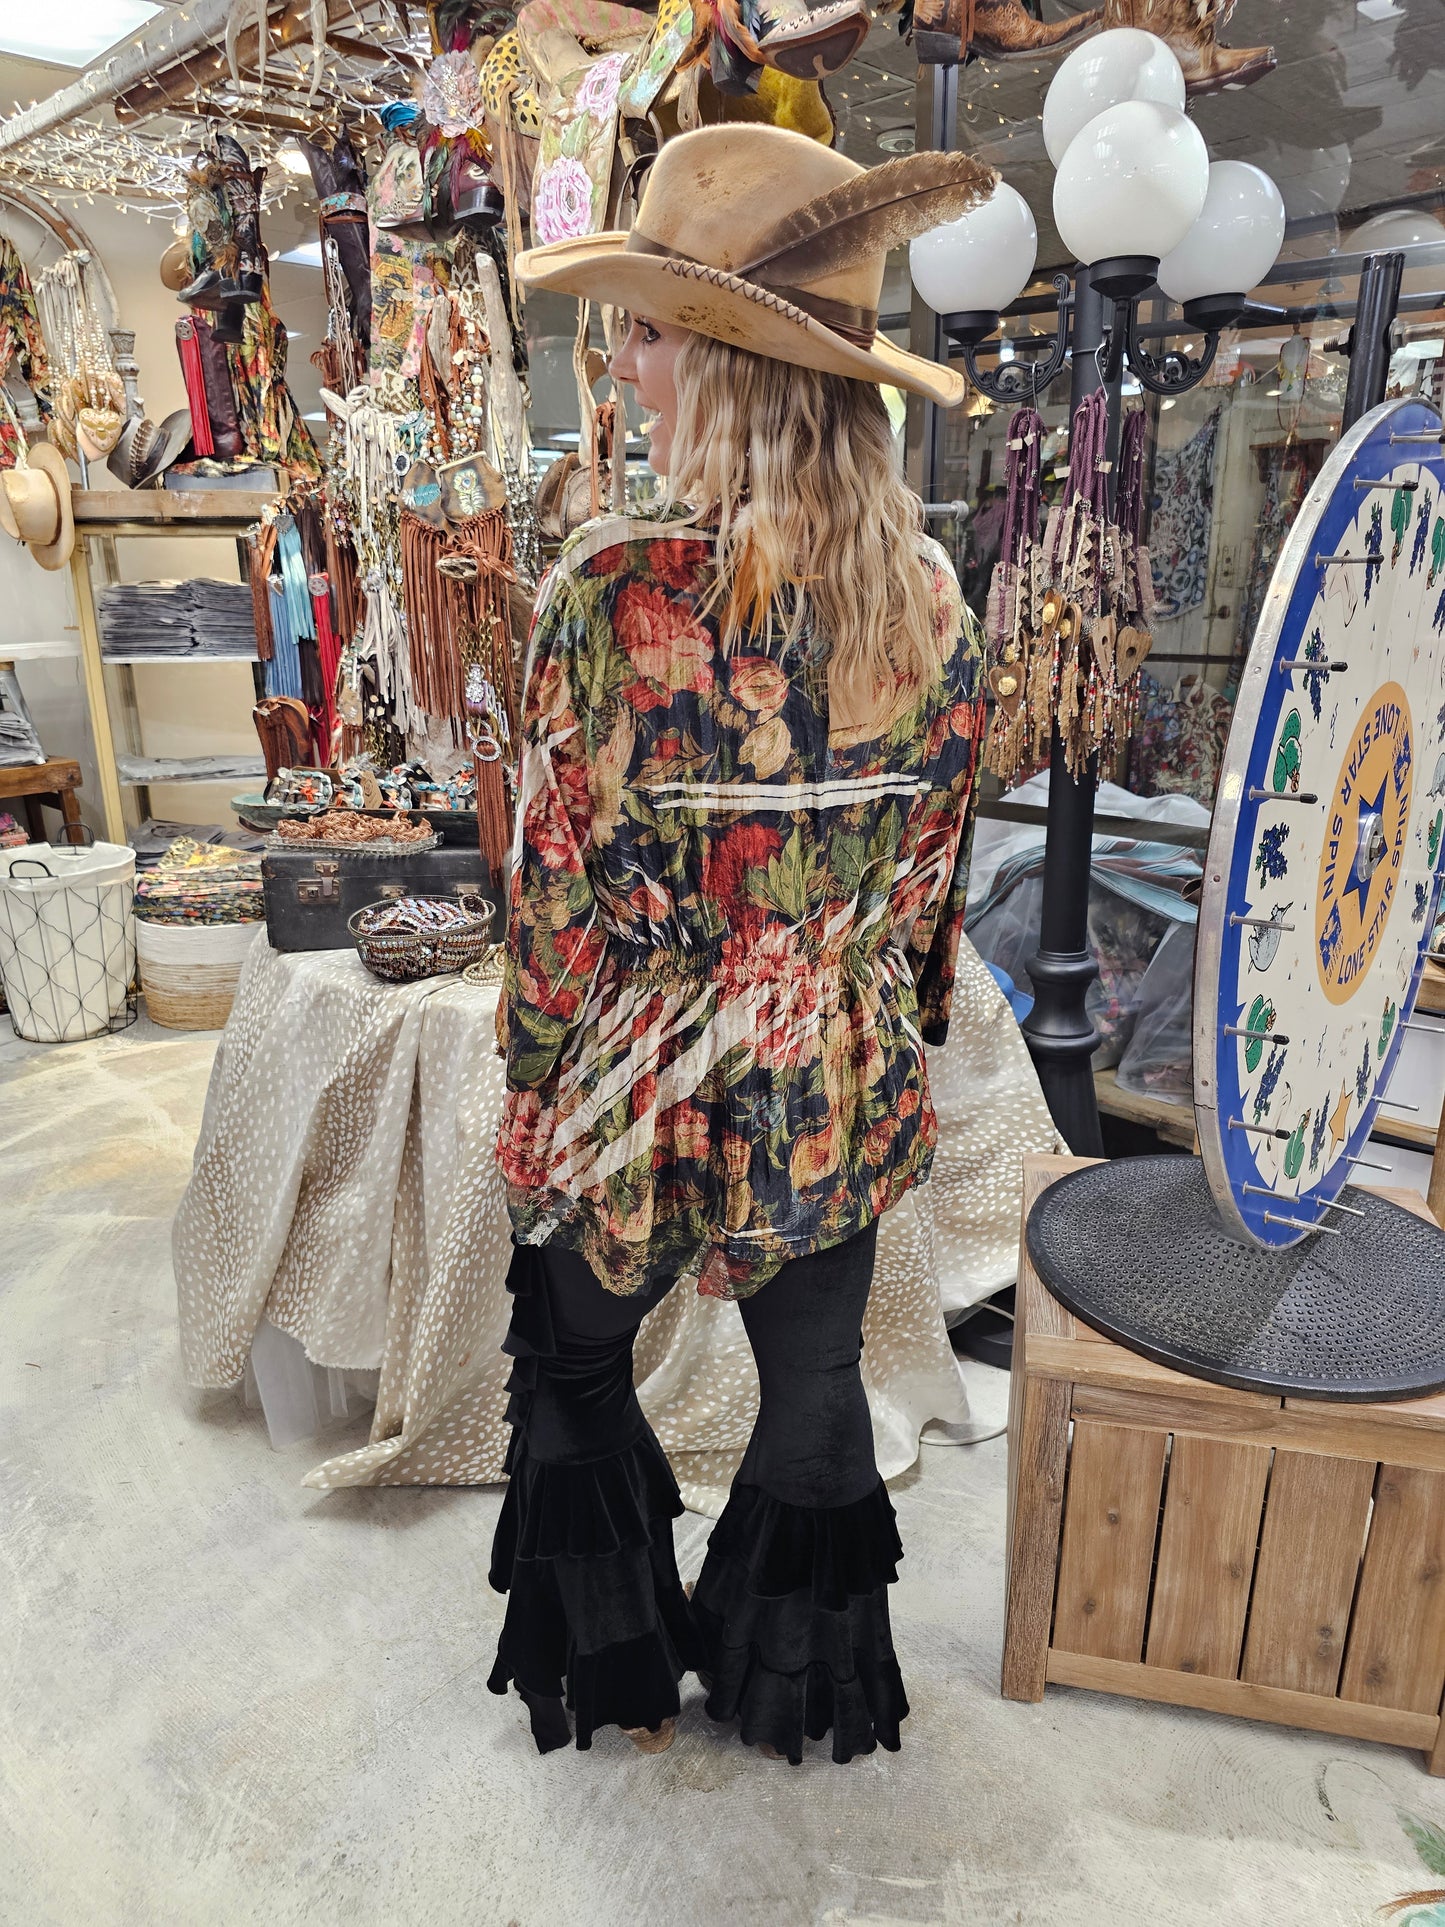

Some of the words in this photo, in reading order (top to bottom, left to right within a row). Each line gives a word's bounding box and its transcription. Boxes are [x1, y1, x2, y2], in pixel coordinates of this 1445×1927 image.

[1341, 722, 1371, 805] STAR
[1374, 703, 1400, 741] LONE
[1323, 814, 1343, 901] SPIN
[1337, 941, 1366, 984] LONE
[1368, 877, 1393, 953] STAR
[1392, 793, 1408, 868] SPIN
